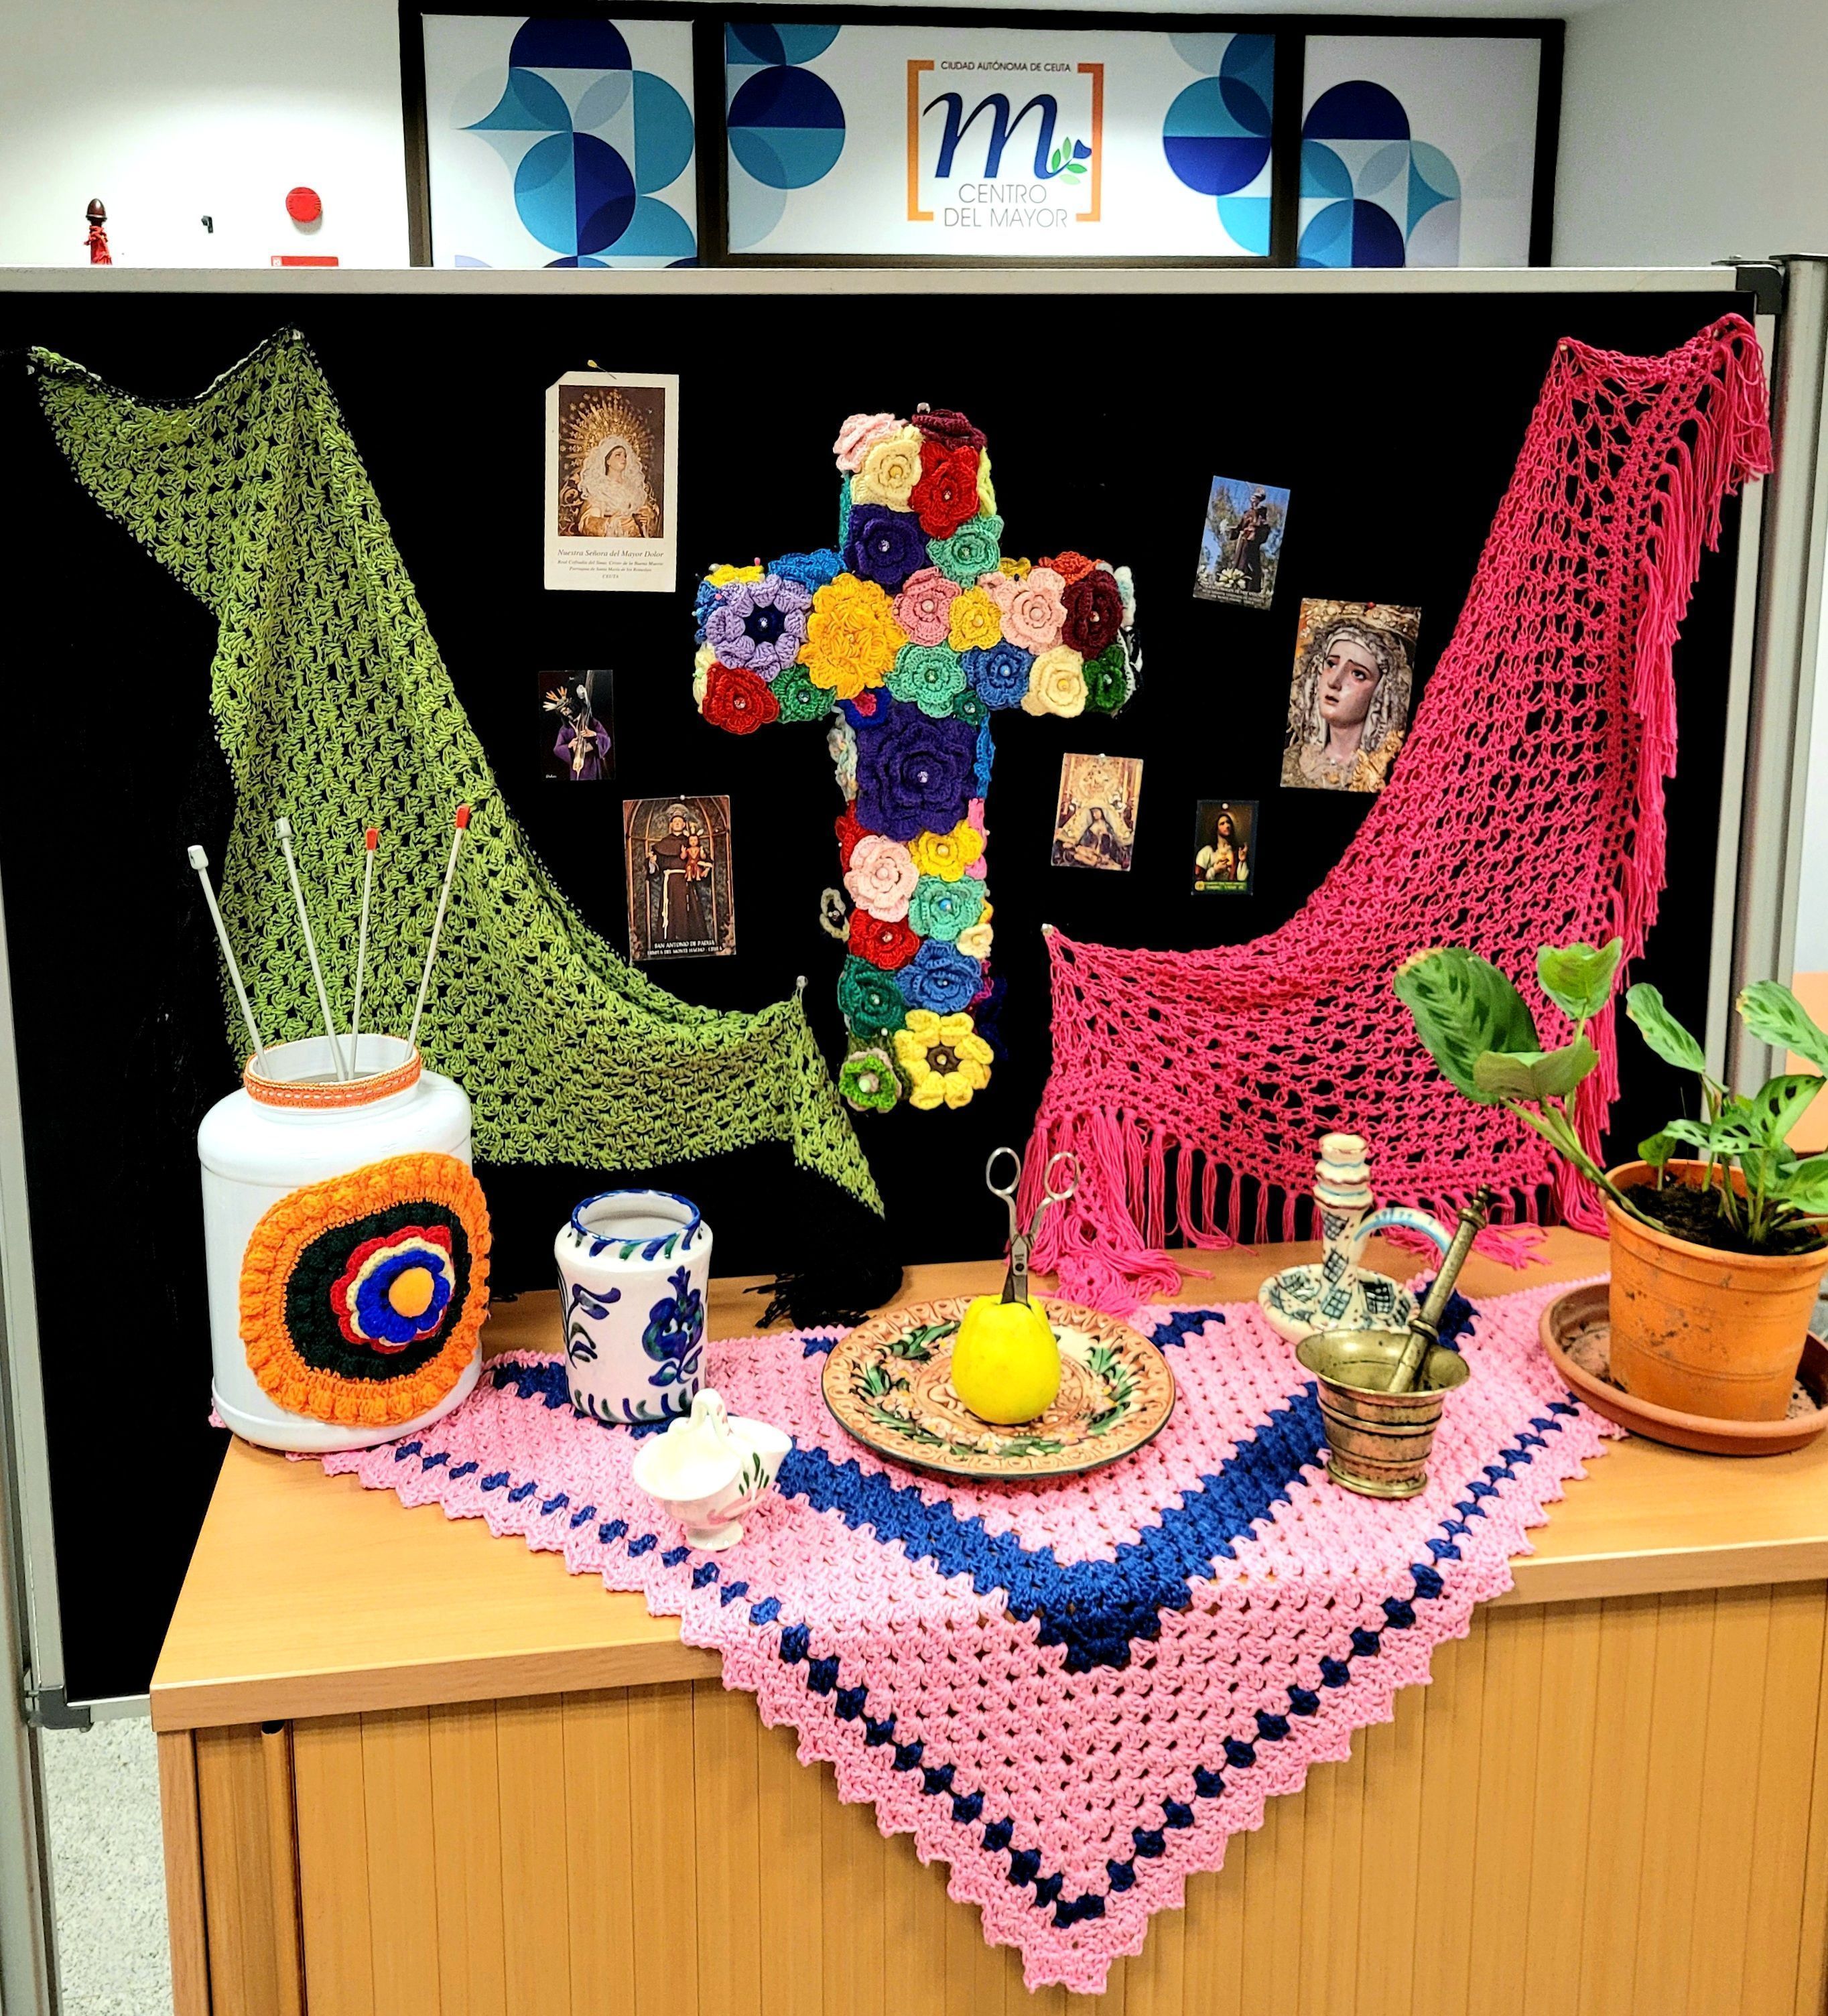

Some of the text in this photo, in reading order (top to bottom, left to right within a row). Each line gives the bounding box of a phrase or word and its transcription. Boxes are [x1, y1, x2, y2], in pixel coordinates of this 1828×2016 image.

[941, 60, 1071, 72] CIUDAD AUTÓNOMA DE CEUTA
[958, 183, 1047, 204] CENTRO
[944, 208, 1067, 228] DEL MAYOR
[621, 550, 643, 558] Mayor
